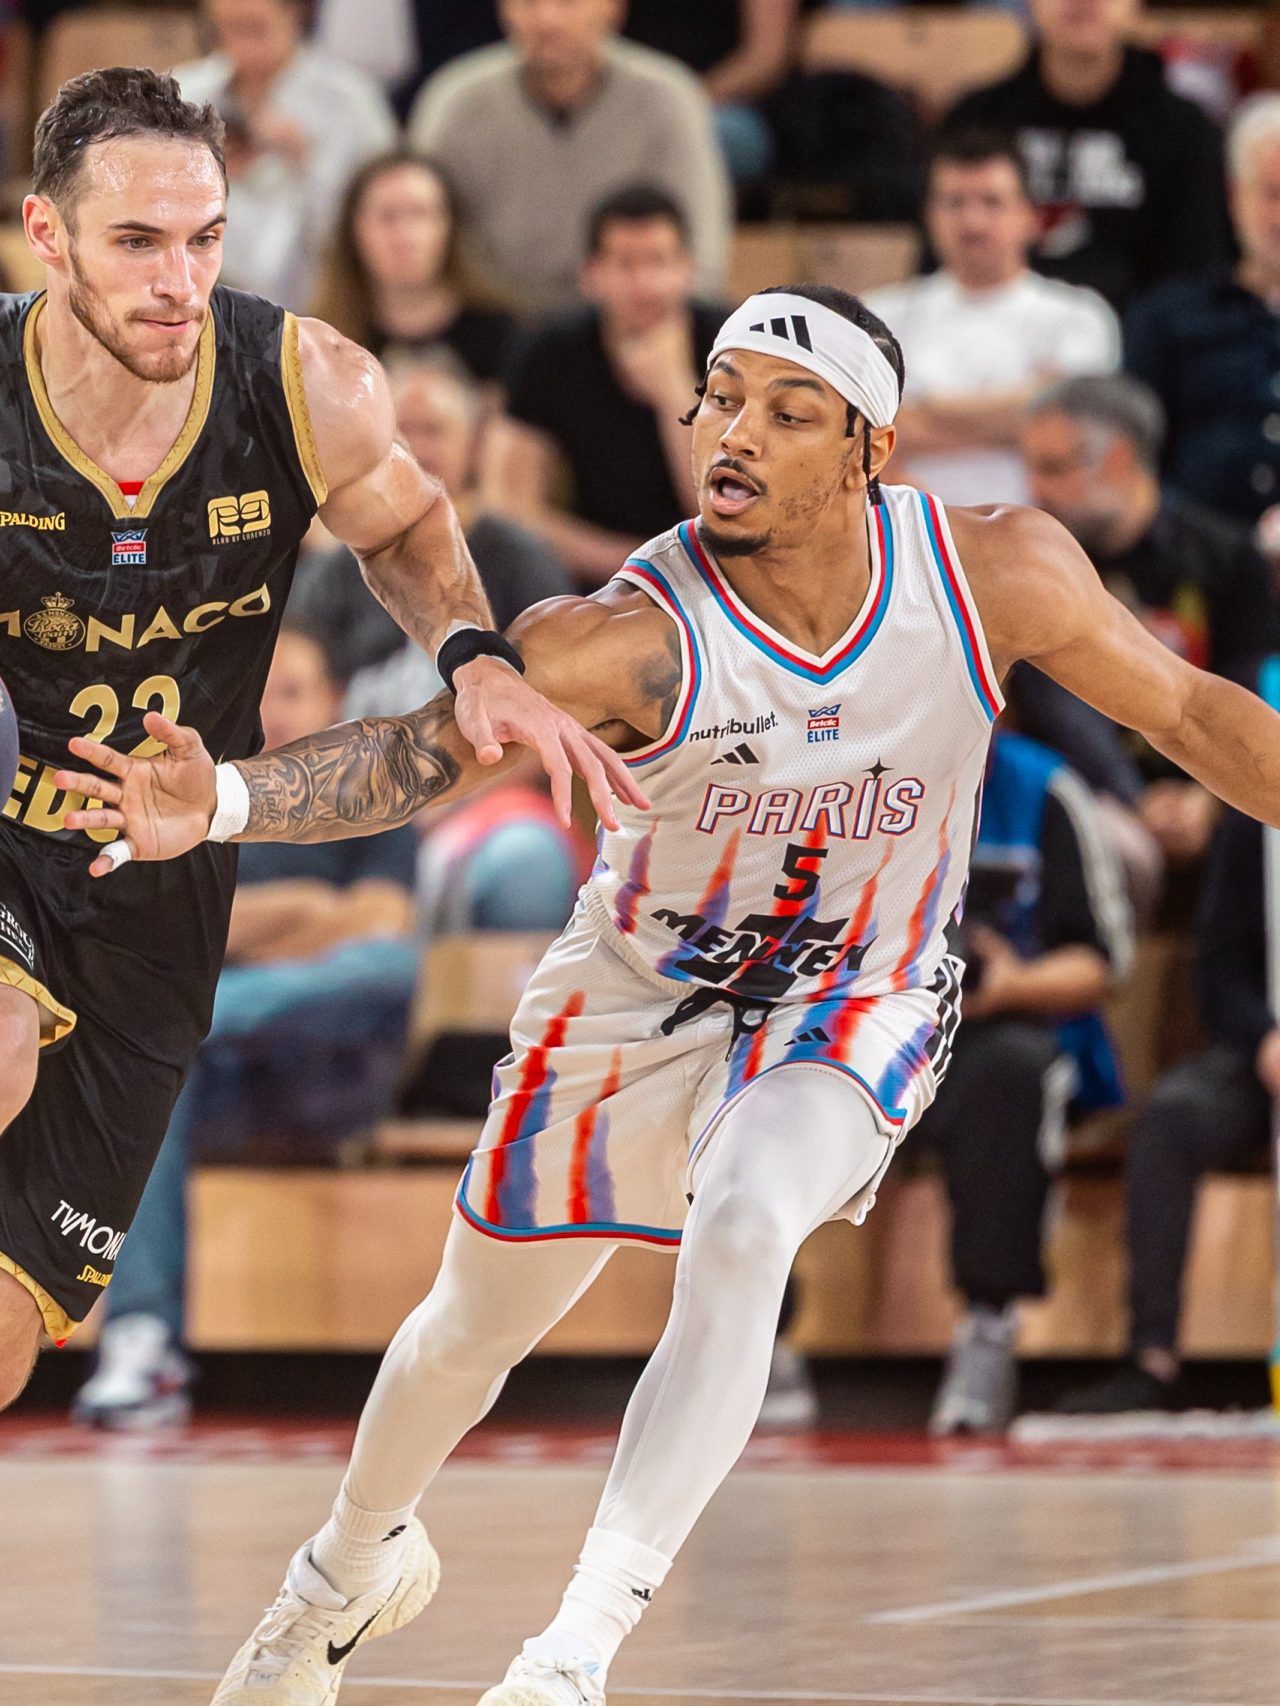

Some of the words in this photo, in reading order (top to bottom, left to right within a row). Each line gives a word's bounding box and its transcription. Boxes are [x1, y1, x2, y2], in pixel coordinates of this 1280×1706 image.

[68, 674, 181, 760] 22
[695, 777, 926, 840] PARIS
[774, 842, 829, 901] 5
